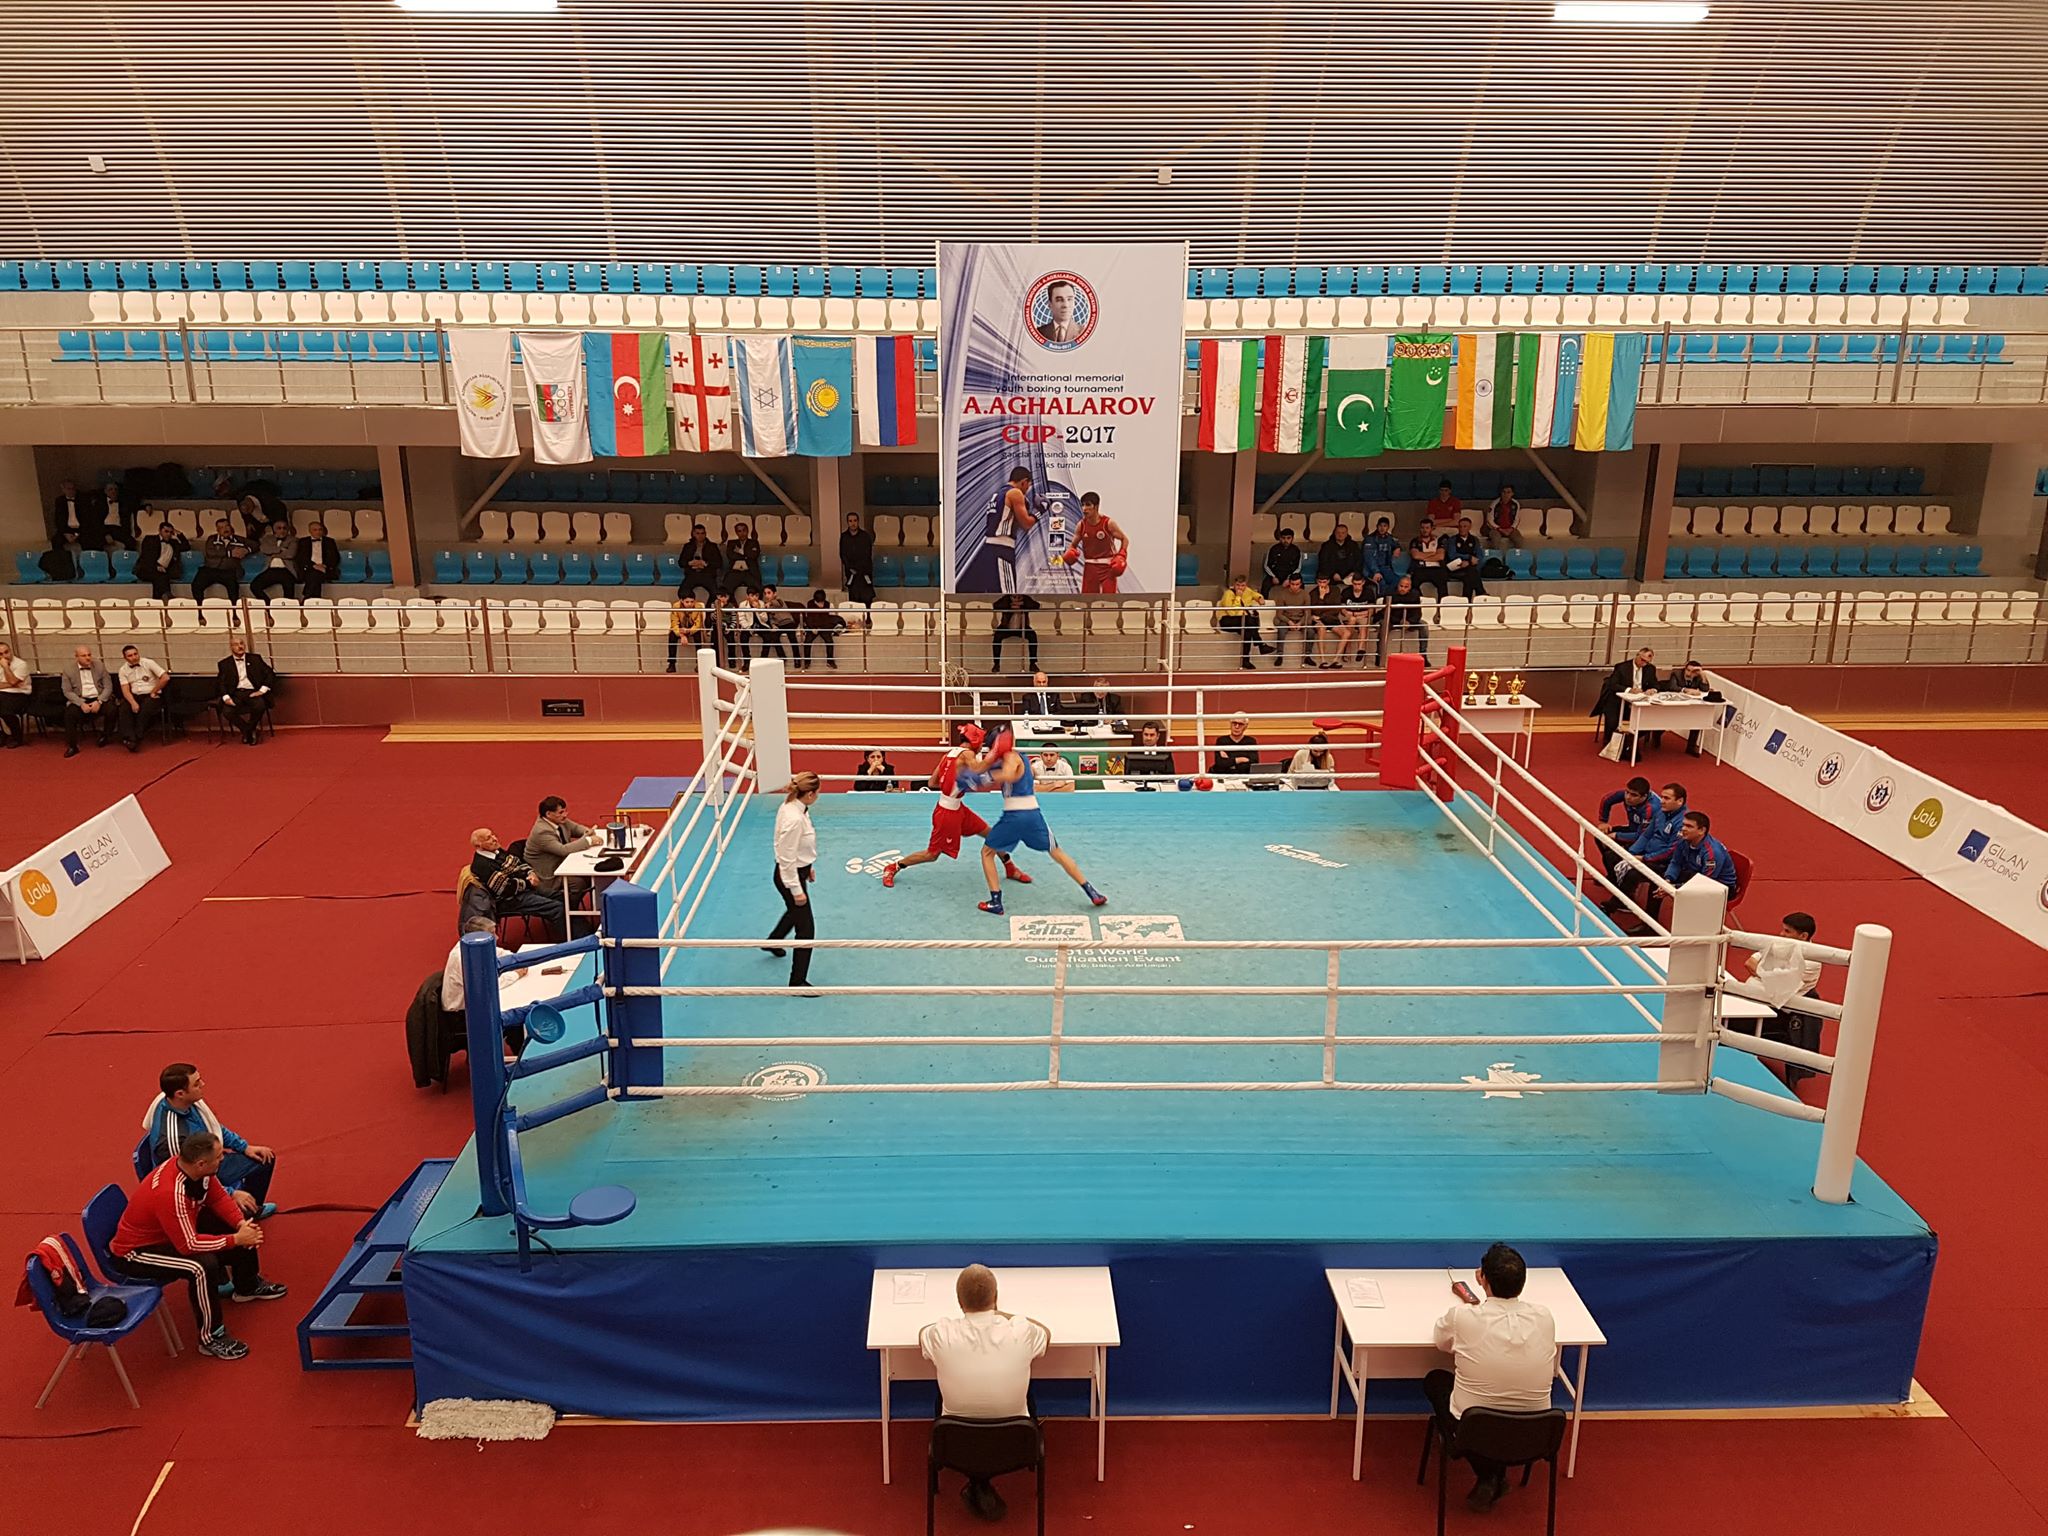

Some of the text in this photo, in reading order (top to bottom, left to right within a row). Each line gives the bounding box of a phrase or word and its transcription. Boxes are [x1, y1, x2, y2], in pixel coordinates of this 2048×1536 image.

[1007, 374, 1124, 382] International memorial
[995, 385, 1124, 394] youth boxing tournament
[963, 396, 1155, 415] A.AGHALAROV
[1001, 425, 1116, 444] CUP-2017
[1785, 738, 1813, 758] GILAN
[1781, 750, 1805, 767] HOLDING
[81, 833, 114, 860] GILAN
[88, 847, 120, 872] HOLDING
[1988, 843, 2029, 871] GILAN
[1980, 857, 2020, 882] HOLDING
[1024, 955, 1182, 963] Quafication Event
[1099, 948, 1148, 956] World
